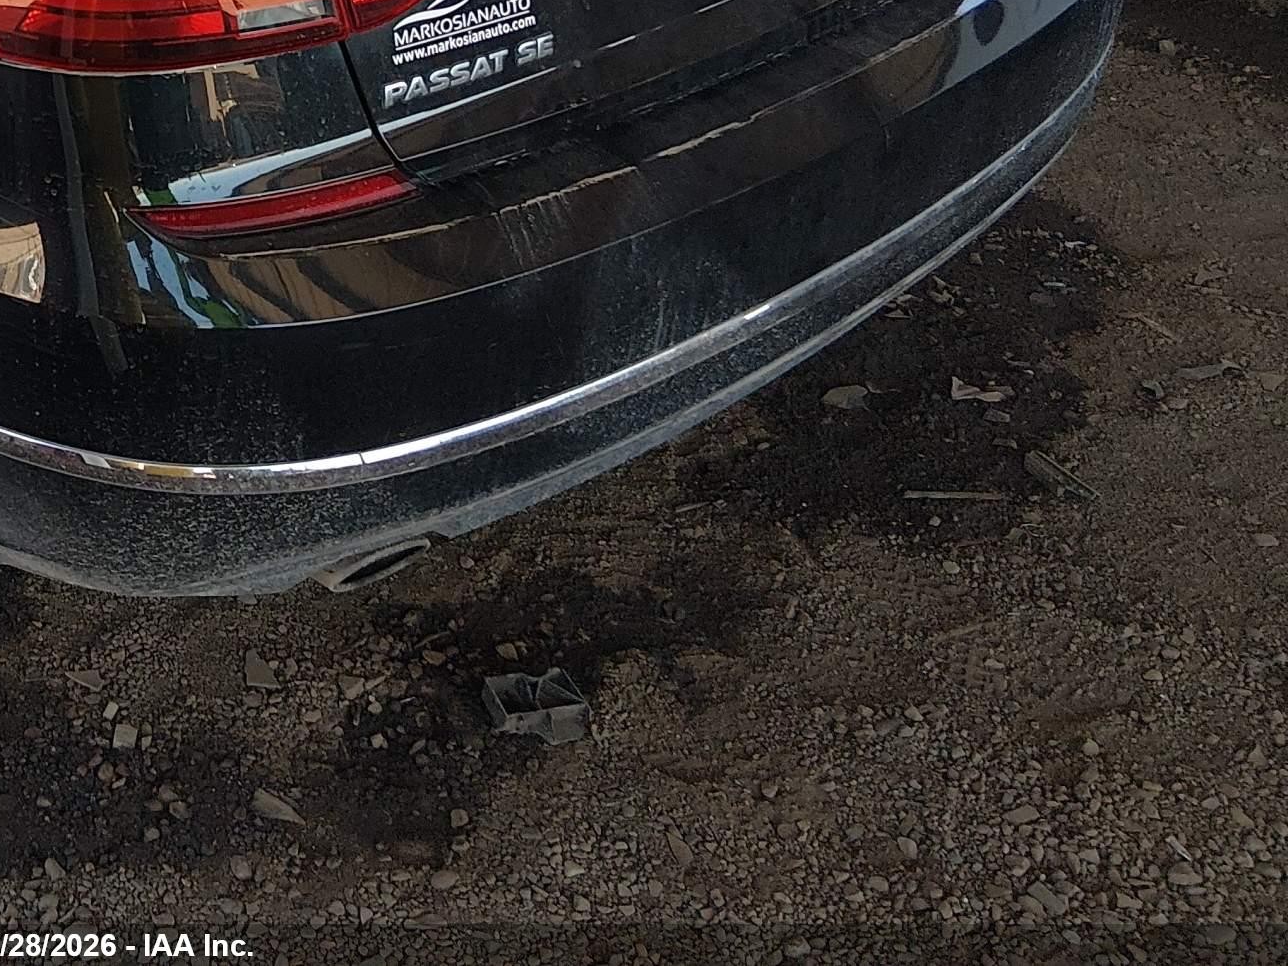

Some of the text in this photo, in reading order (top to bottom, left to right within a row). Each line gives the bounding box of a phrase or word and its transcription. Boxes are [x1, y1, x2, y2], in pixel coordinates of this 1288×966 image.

[384, 33, 554, 108] PASSAT SE
[392, 15, 536, 66] www.markosianauto.com
